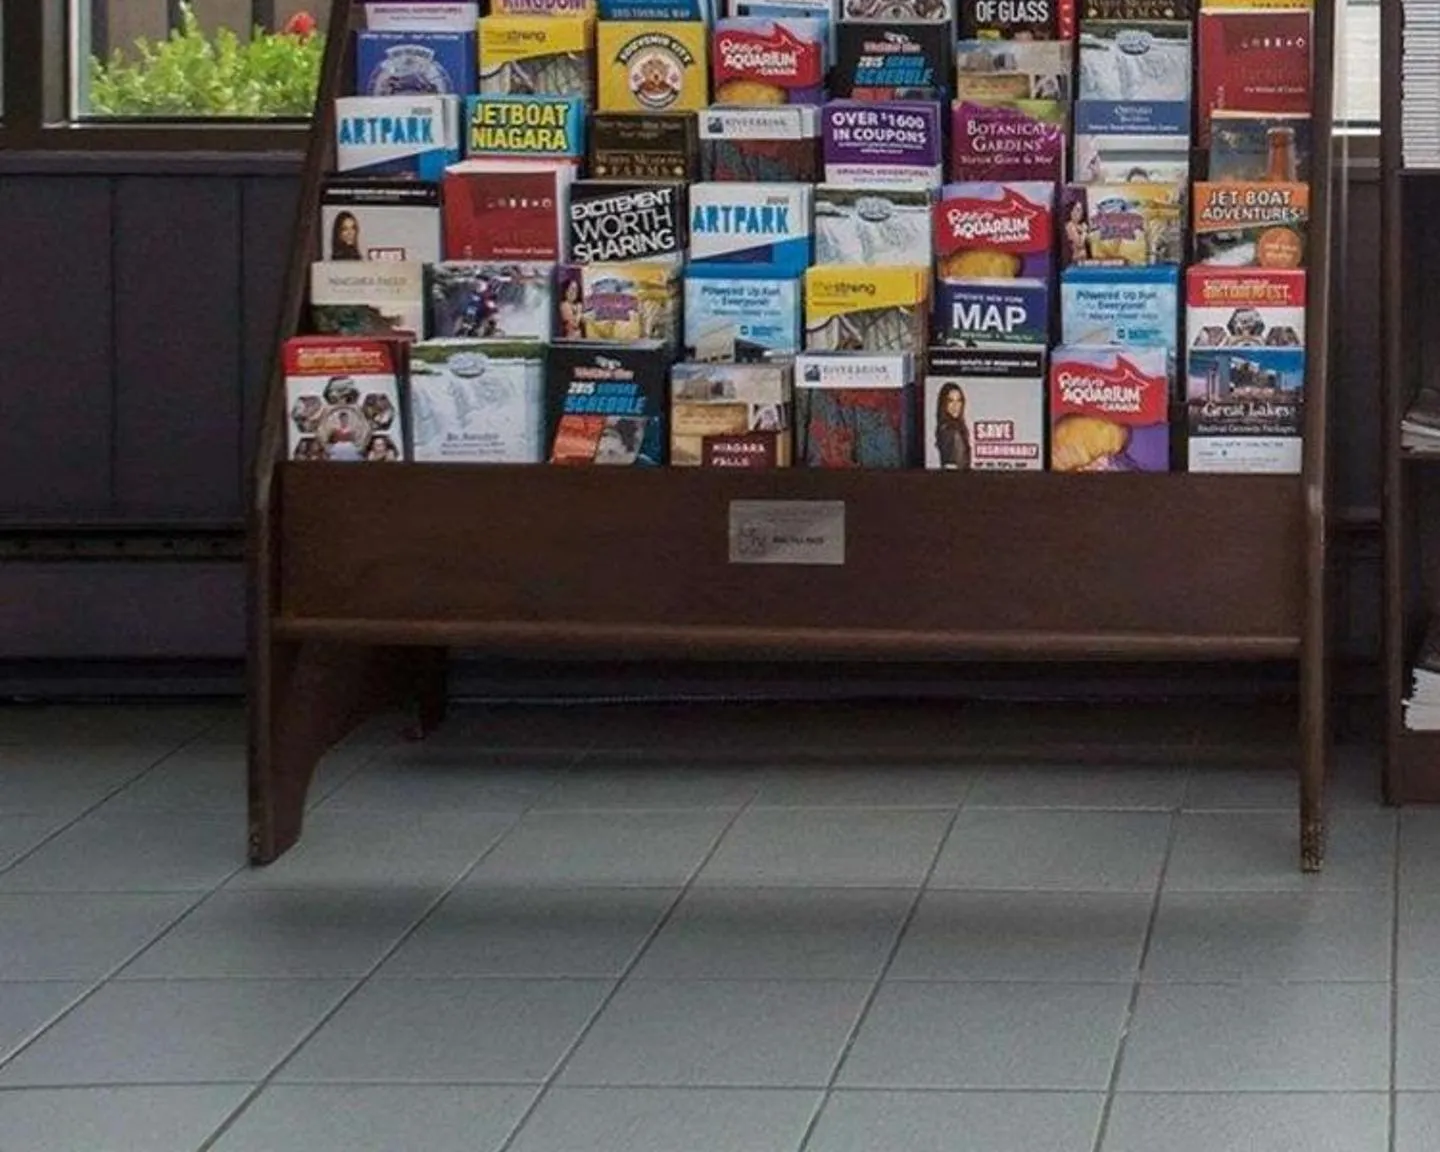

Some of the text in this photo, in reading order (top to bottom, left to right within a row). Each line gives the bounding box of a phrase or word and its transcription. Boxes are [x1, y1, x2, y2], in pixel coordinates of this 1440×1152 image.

[976, 1, 1049, 24] OF GLASS
[723, 50, 798, 71] AQUARIUM
[472, 103, 570, 127] JETBOAT
[832, 112, 878, 127] OVER
[339, 117, 434, 145] ARTPARK
[472, 128, 568, 151] NIAGARA
[832, 127, 928, 145] IN COUPONS
[967, 120, 1052, 138] BOTANICAL
[972, 137, 1045, 154] GARDENS
[570, 188, 673, 220] EXCITEMENT
[1210, 191, 1291, 207] JET BOAT
[572, 206, 673, 243] WORTH
[692, 205, 791, 235] ARTPARK
[954, 216, 1030, 240] AQUARIUM
[573, 228, 675, 265] SHARING
[952, 303, 1027, 333] MAP
[568, 382, 596, 395] 2015
[1062, 386, 1141, 407] AQUARIUM
[564, 396, 646, 414] SCHEDULE
[1201, 400, 1292, 418] Great Lakes
[976, 423, 1012, 439] SAVE
[712, 443, 766, 453] NIAGARA
